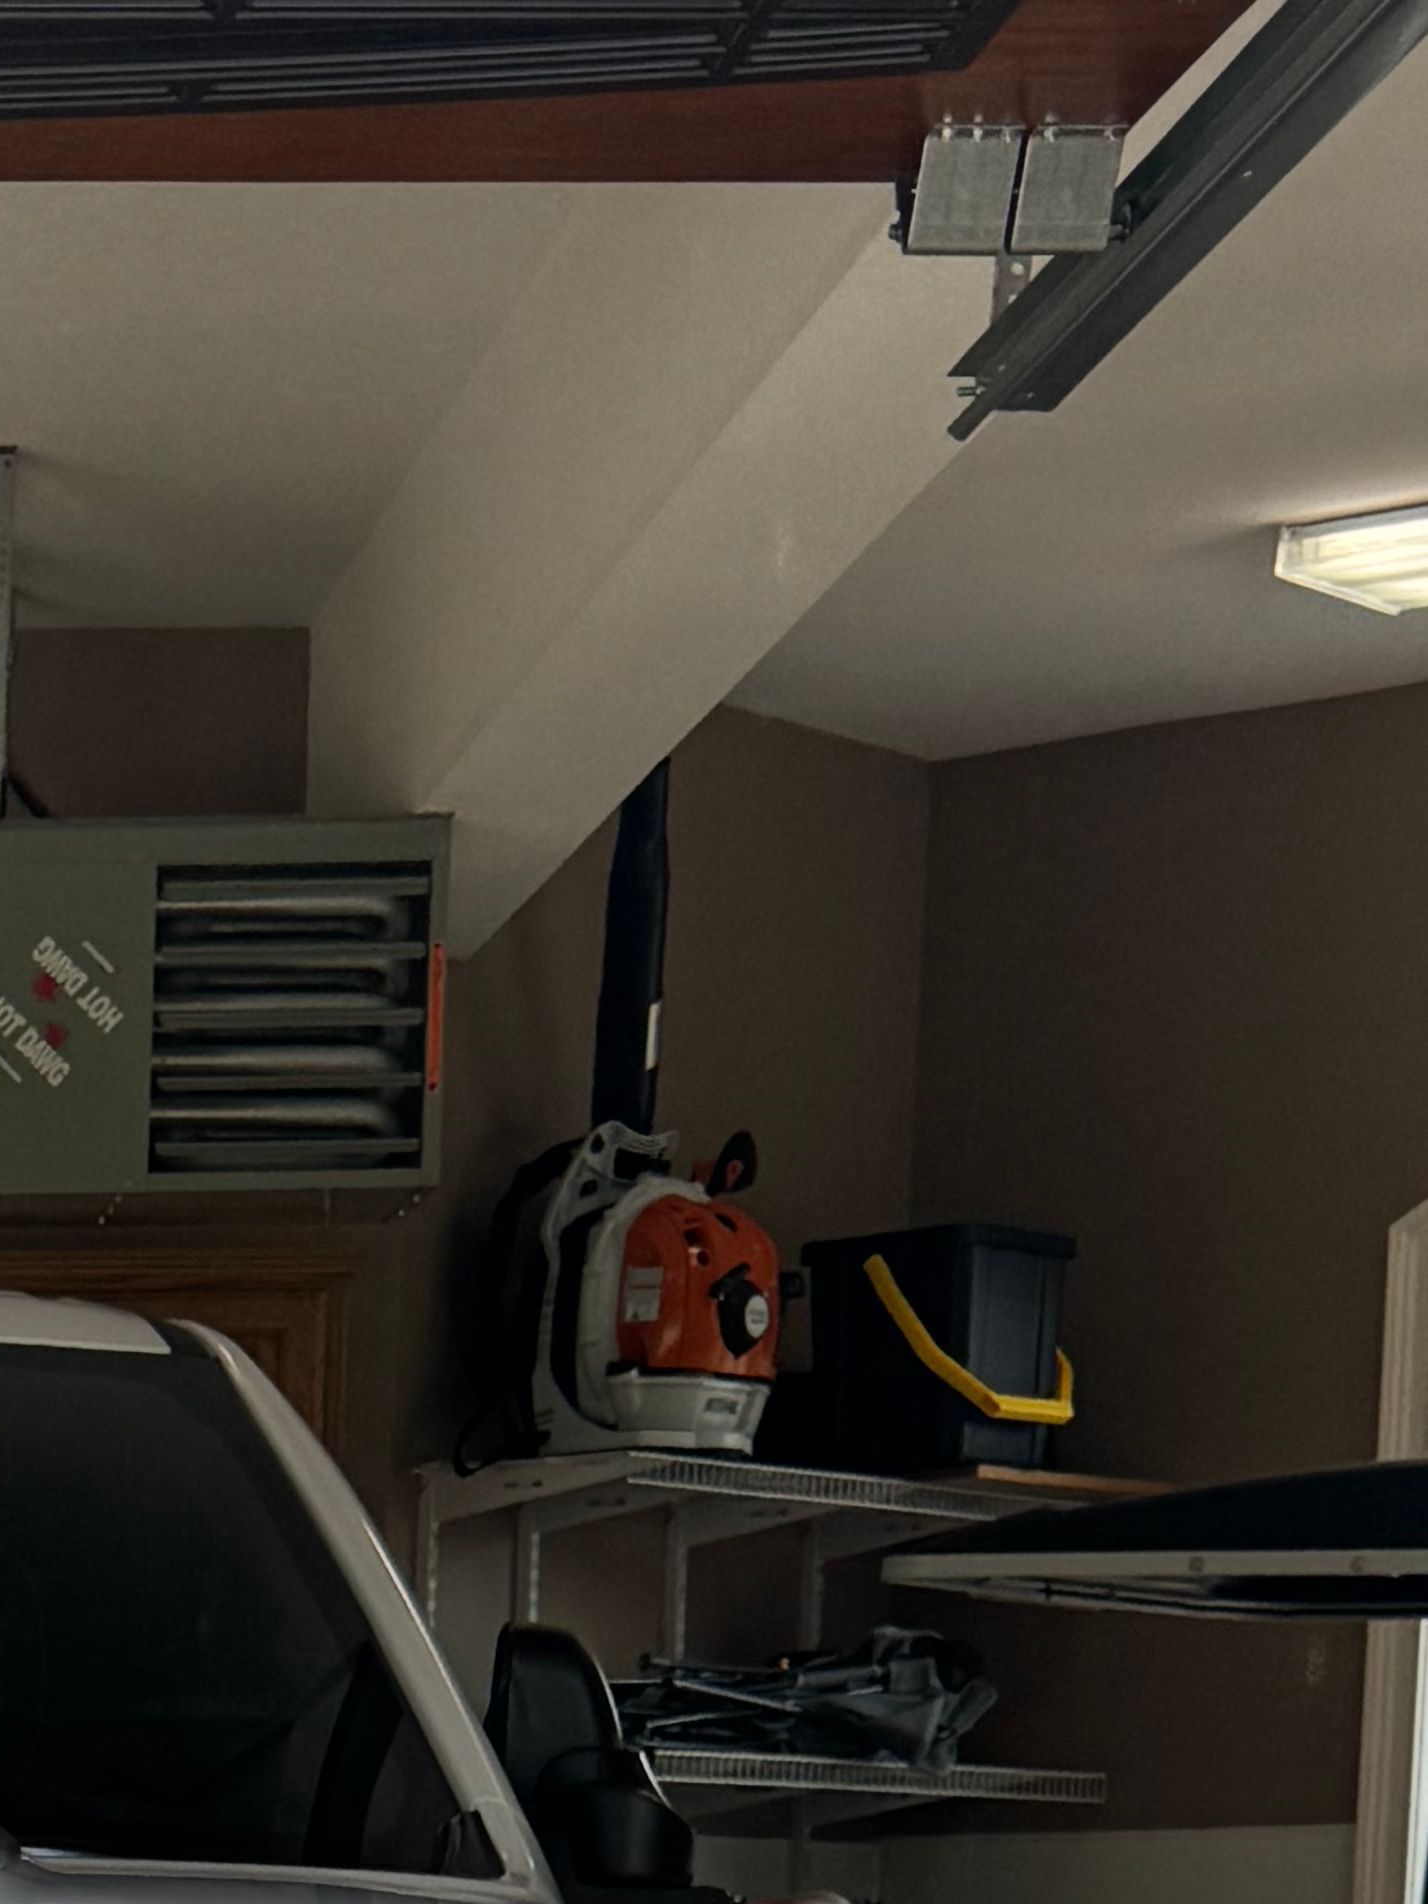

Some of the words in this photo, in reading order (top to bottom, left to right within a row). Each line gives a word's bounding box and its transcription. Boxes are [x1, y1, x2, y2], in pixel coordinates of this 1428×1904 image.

[32, 936, 88, 997] DAWG
[76, 986, 124, 1034] HOT
[15, 1026, 71, 1087] DAWG
